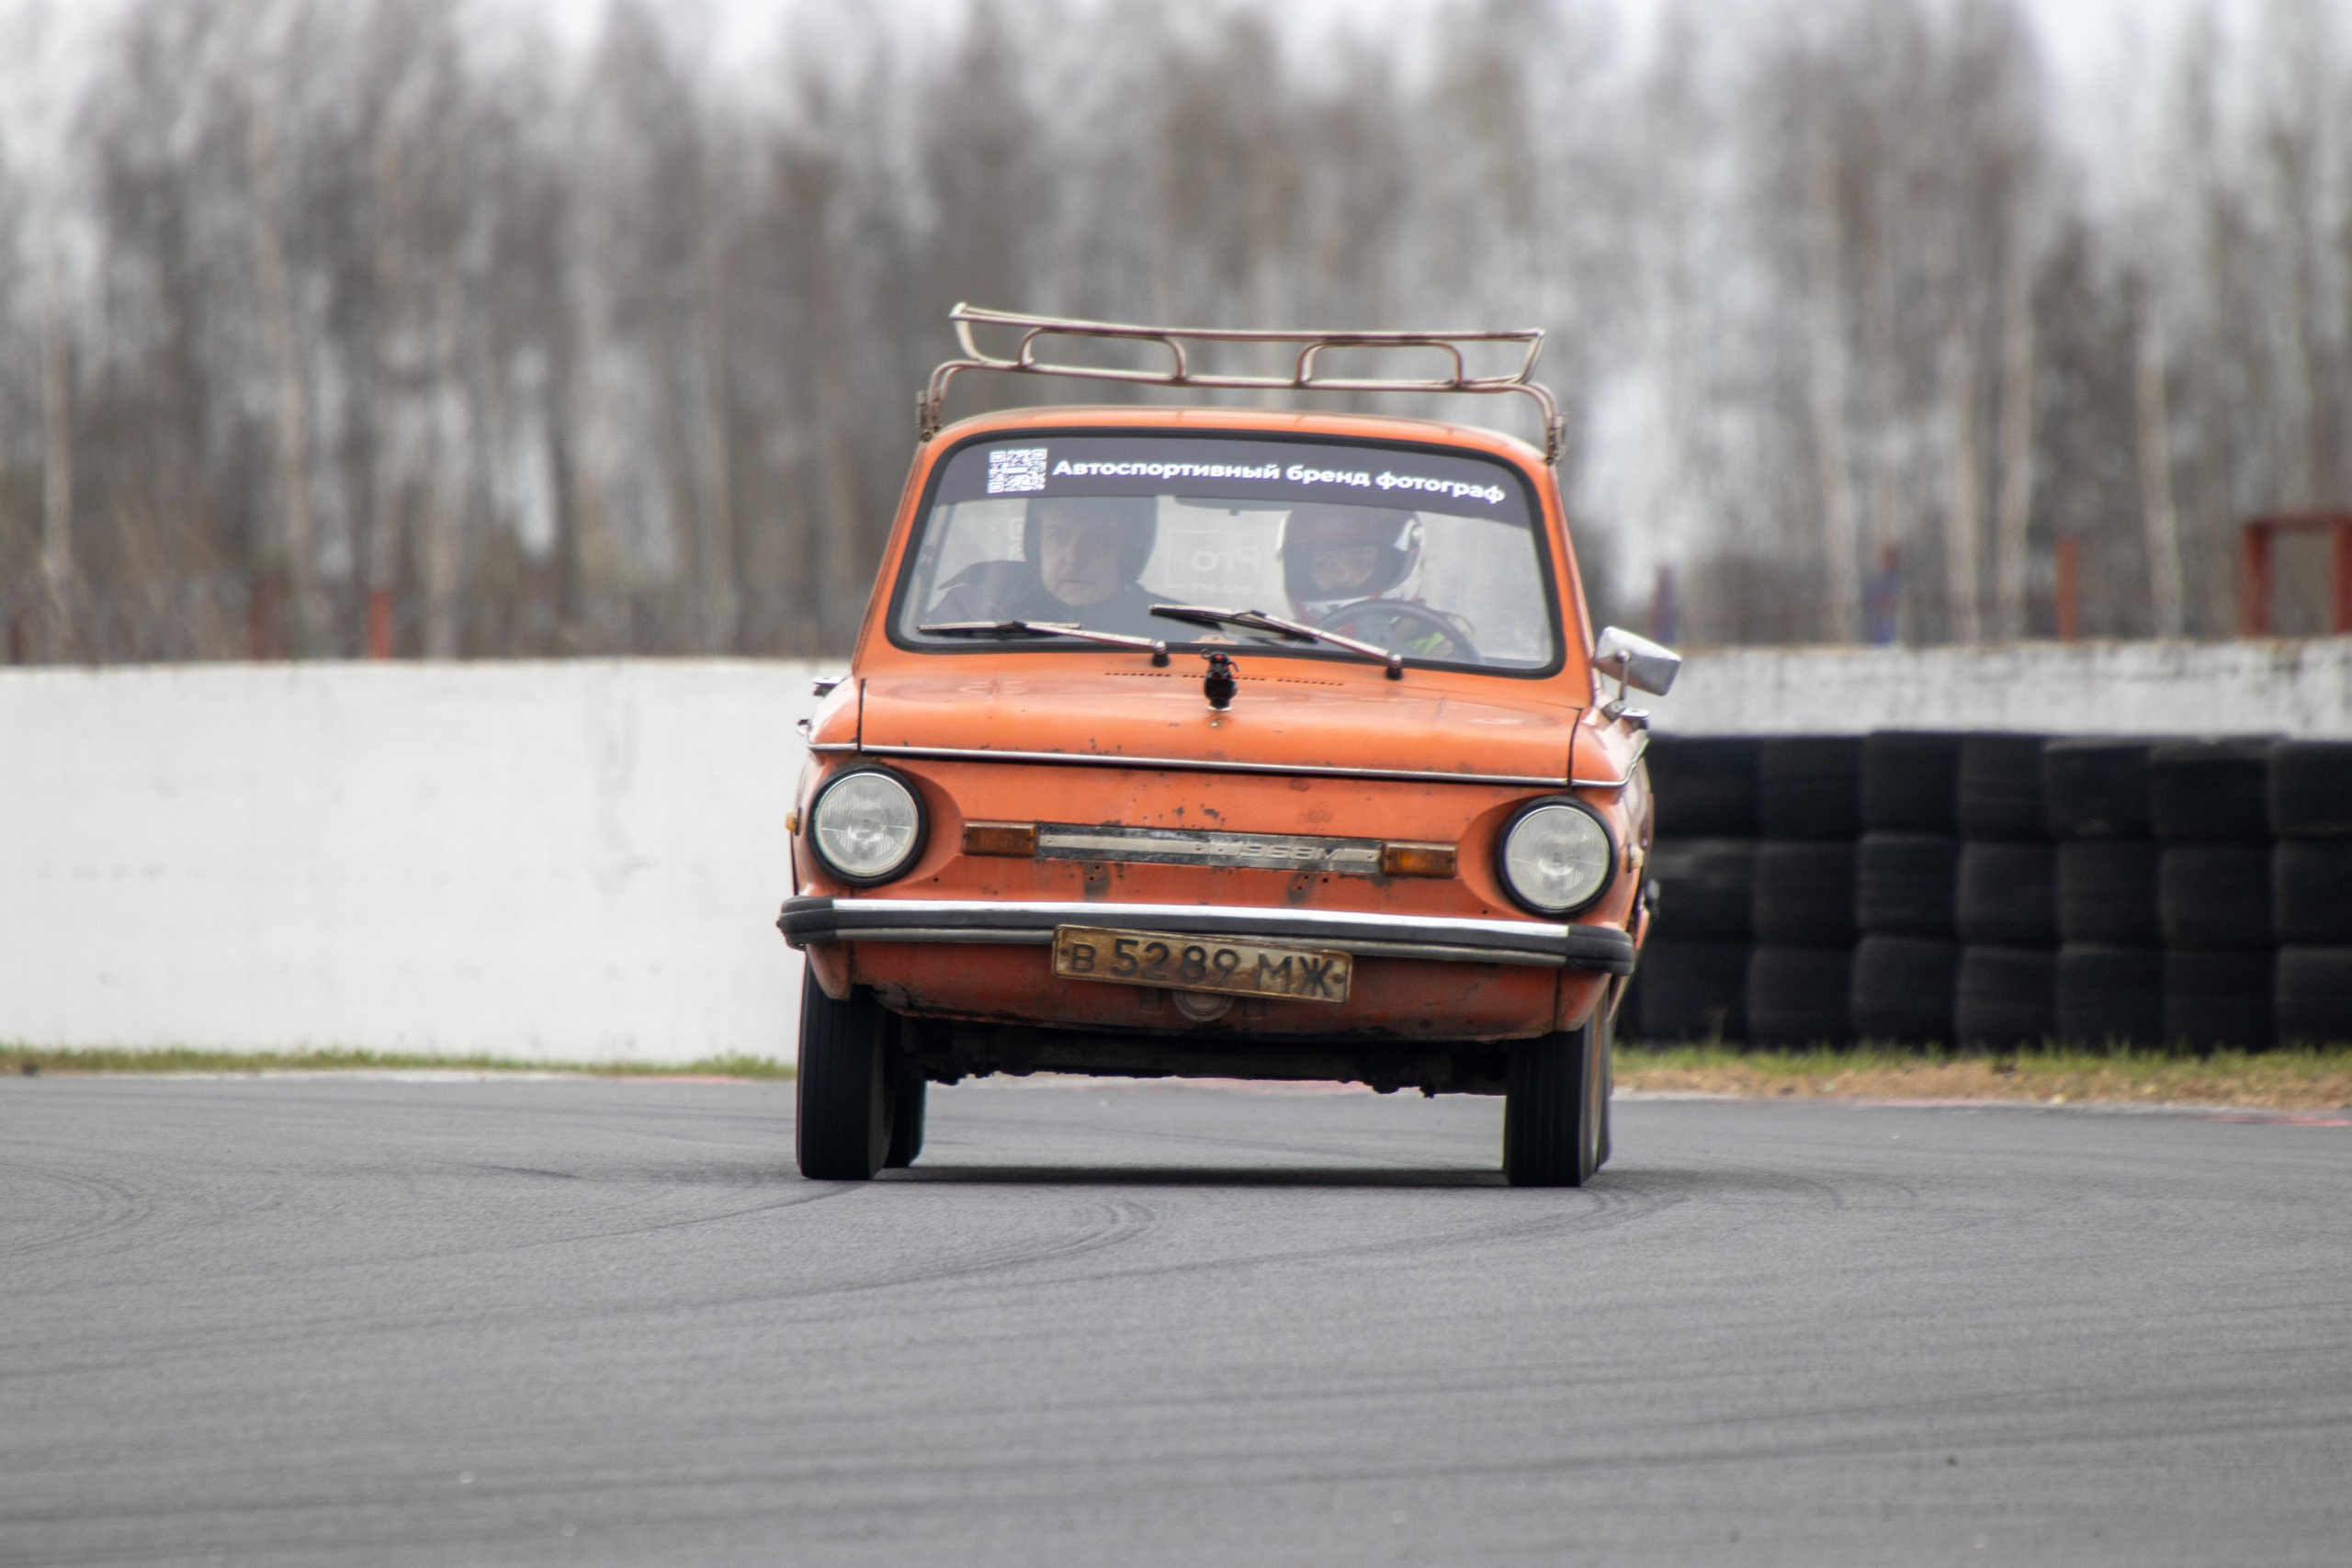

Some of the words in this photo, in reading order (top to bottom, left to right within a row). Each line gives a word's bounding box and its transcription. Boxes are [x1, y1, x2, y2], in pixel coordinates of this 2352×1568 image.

[1051, 460, 1281, 479] Автоспортивный
[1285, 464, 1371, 487] бренд
[1374, 471, 1507, 504] фотограф
[1069, 942, 1098, 974] В
[1110, 937, 1241, 987] 5289
[1256, 950, 1333, 998] МЖ
